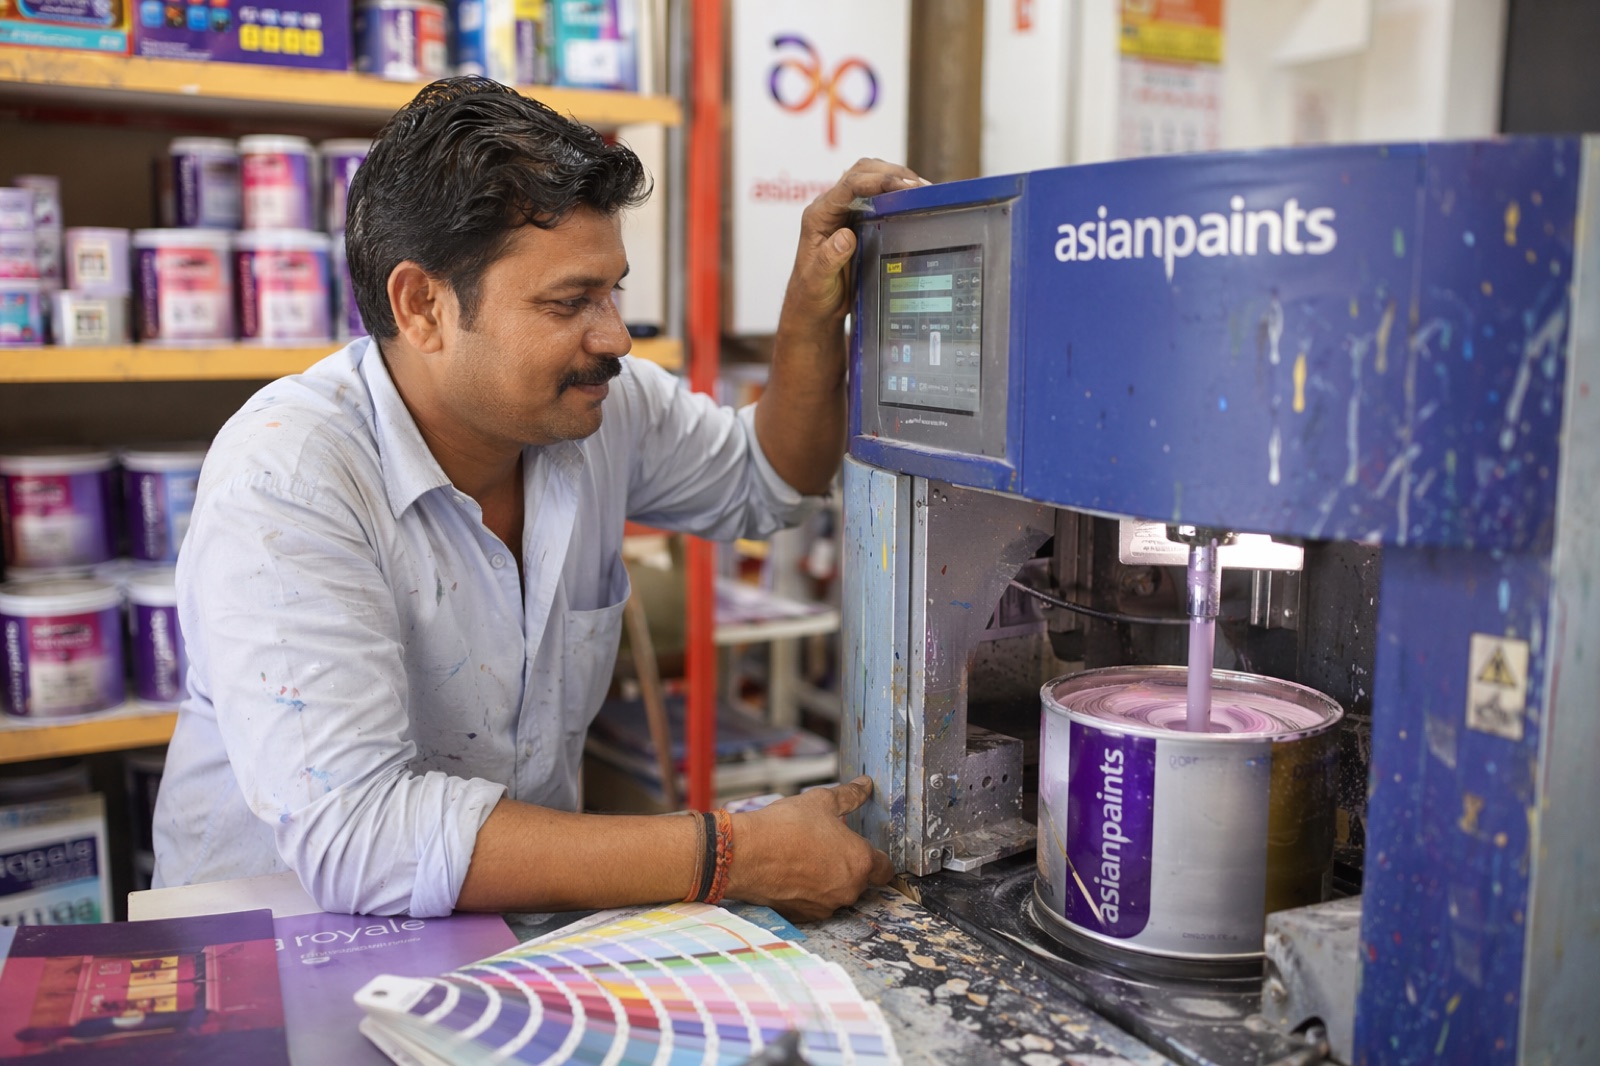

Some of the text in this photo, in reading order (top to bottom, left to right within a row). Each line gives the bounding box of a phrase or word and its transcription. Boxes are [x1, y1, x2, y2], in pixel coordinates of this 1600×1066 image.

[1055, 195, 1337, 284] asianpaints
[1094, 748, 1133, 924] asianpaints
[294, 919, 425, 947] royale
